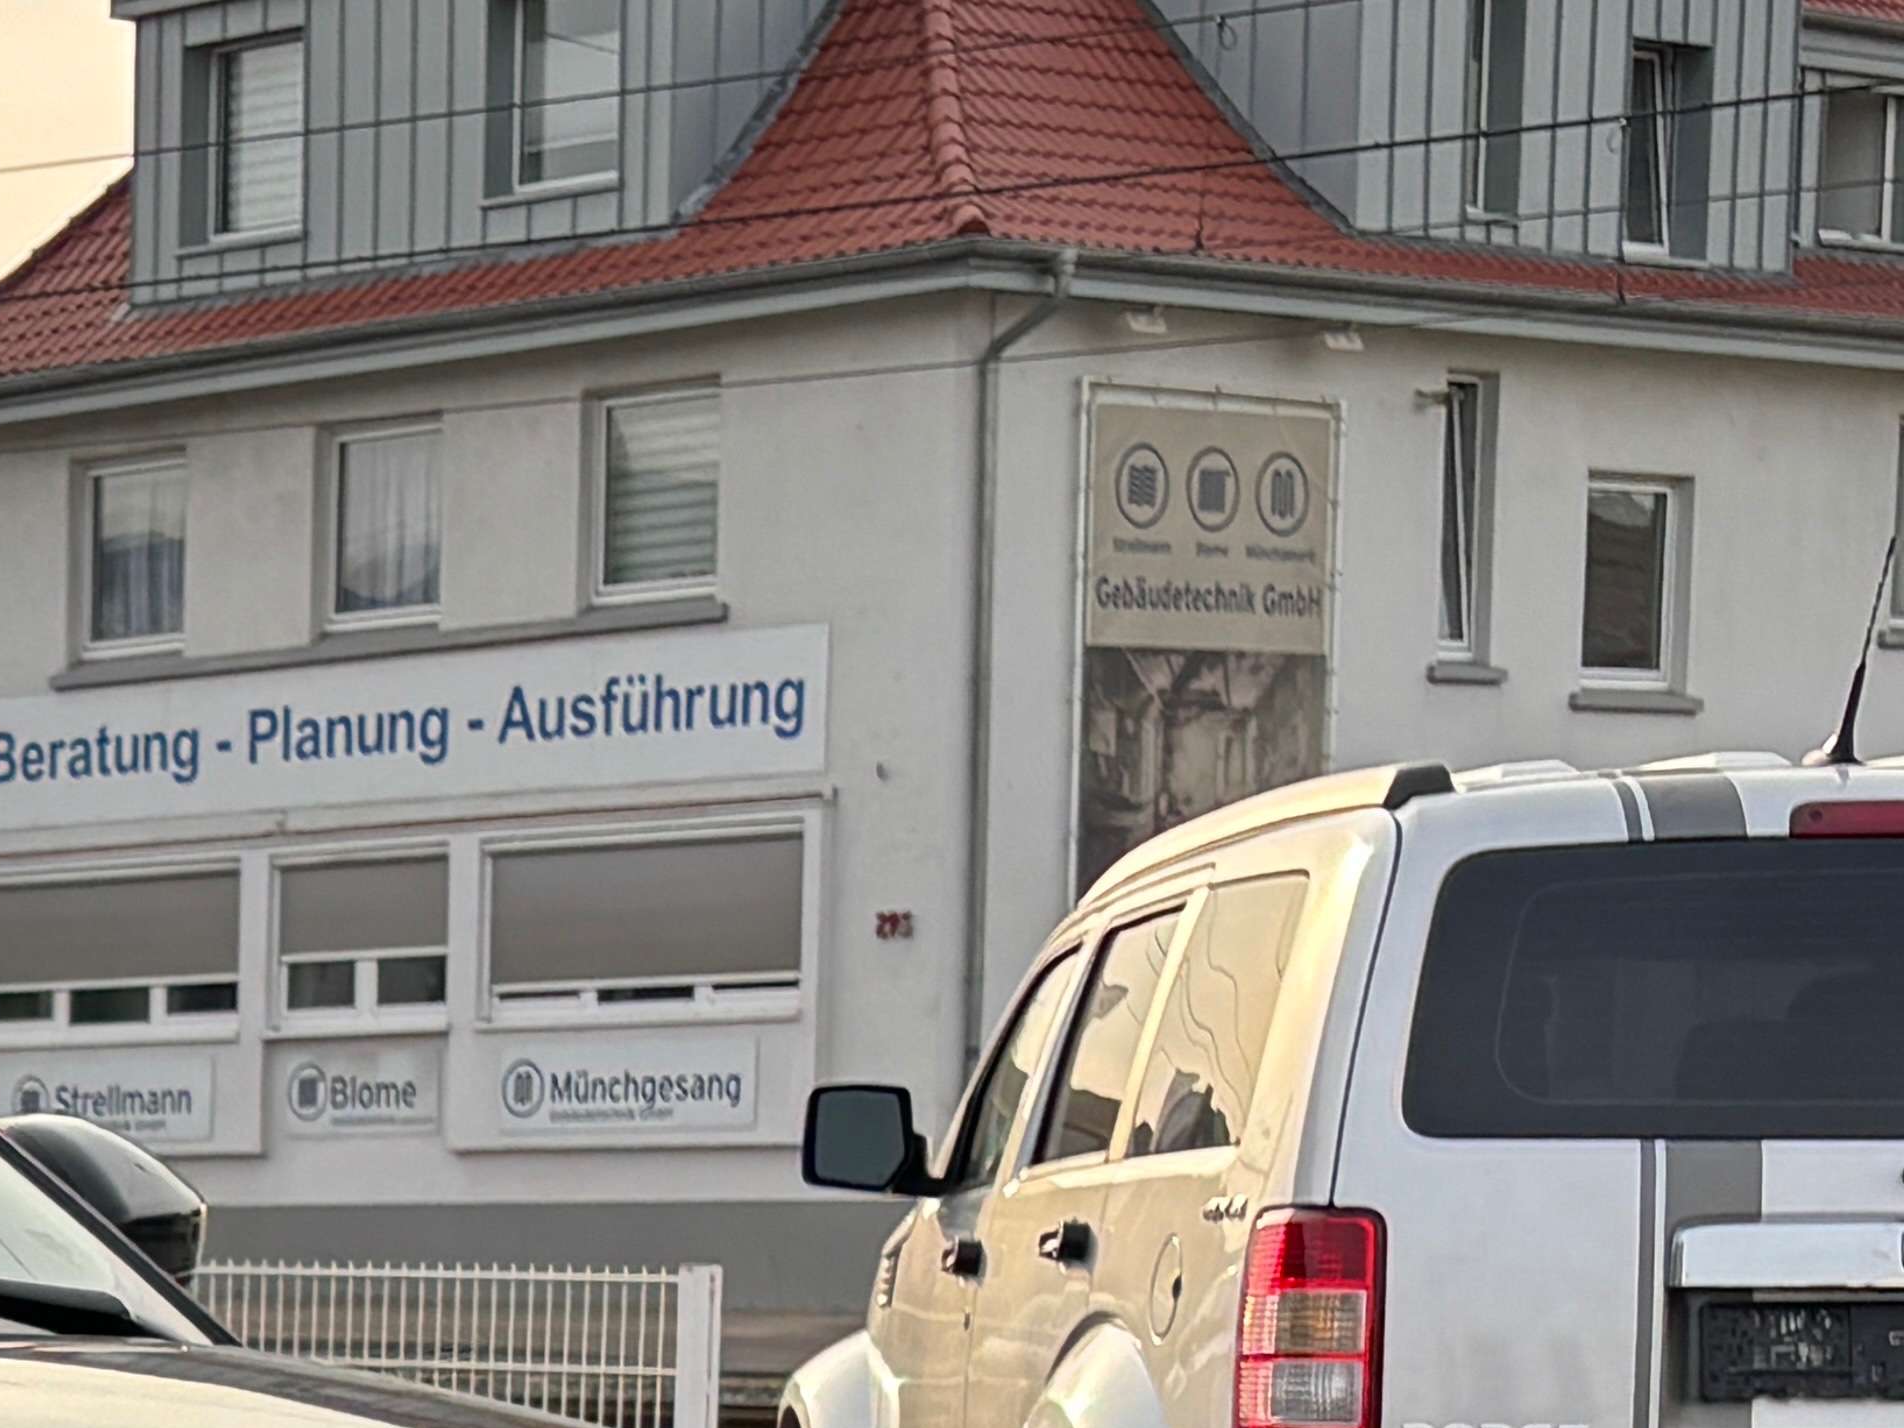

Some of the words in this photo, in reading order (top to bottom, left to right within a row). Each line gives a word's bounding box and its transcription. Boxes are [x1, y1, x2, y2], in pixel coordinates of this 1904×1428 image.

[1095, 576, 1256, 614] Gebäudetechnik
[1262, 582, 1323, 617] GmbH
[247, 704, 450, 766] Planung
[497, 674, 805, 741] Ausführung
[54, 1083, 192, 1117] Strellmann
[330, 1074, 417, 1110] Blome
[549, 1067, 742, 1112] Münchgesang
